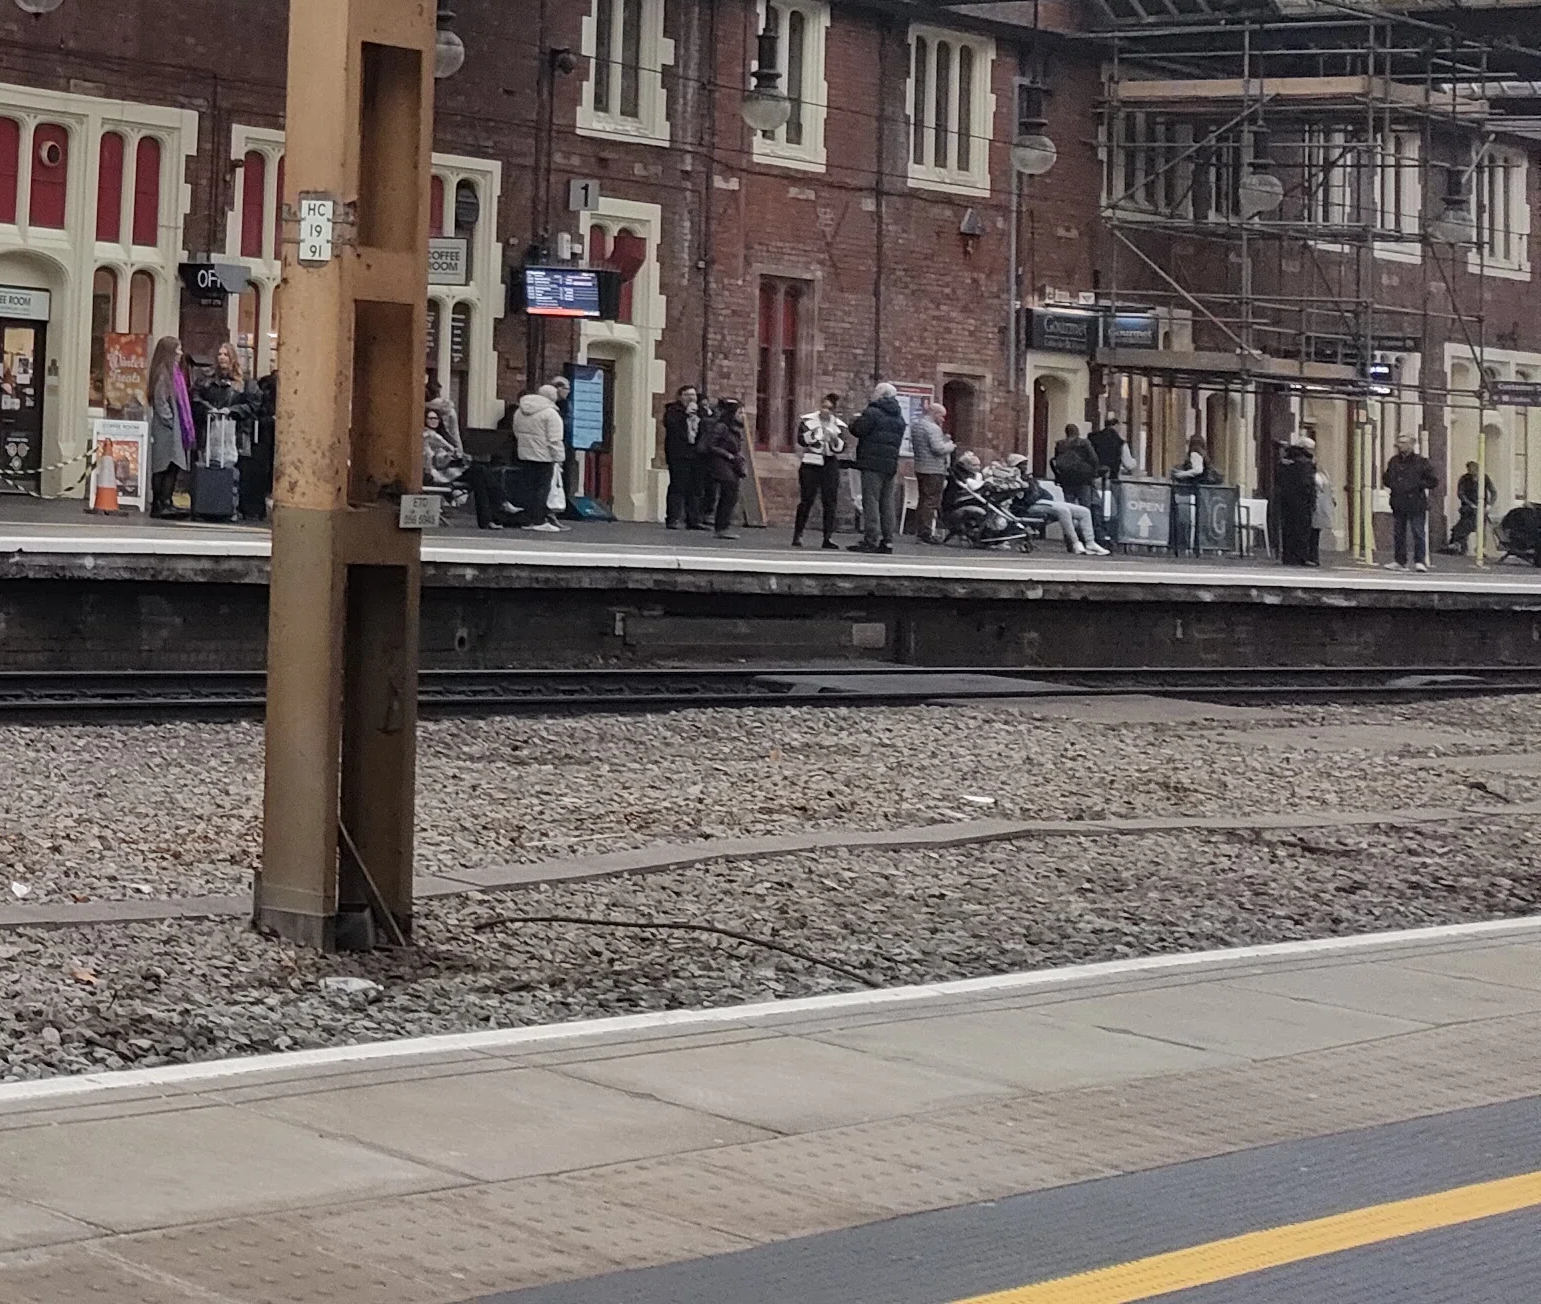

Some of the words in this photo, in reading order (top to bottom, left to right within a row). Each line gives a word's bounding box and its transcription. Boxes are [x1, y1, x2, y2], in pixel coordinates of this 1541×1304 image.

[580, 183, 590, 207] 1
[307, 203, 326, 217] HC
[309, 224, 323, 238] 19
[309, 244, 322, 258] 91
[8, 295, 32, 307] ROOM
[1127, 500, 1165, 514] OPEN
